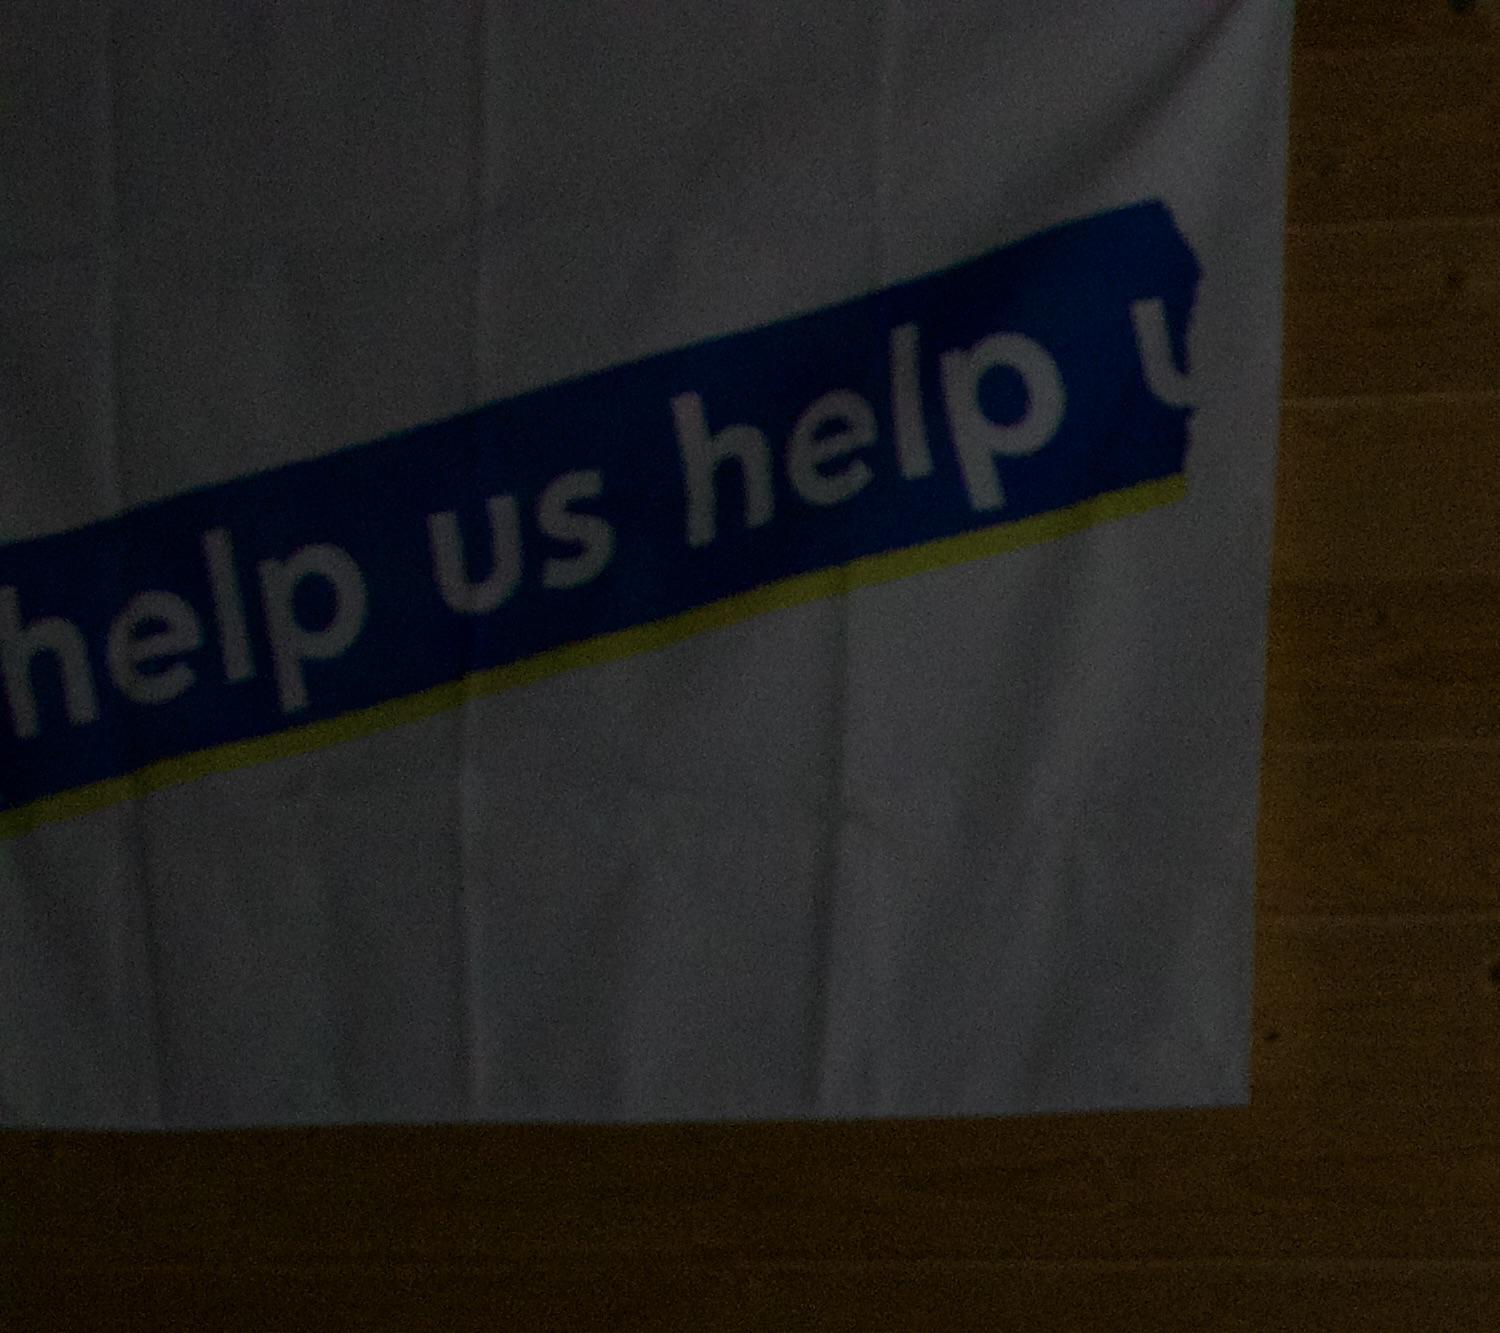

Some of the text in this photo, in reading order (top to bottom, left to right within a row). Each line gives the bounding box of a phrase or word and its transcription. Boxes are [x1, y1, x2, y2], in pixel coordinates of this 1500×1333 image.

[0, 527, 368, 738] help
[426, 468, 617, 615] us
[670, 323, 1067, 547] help
